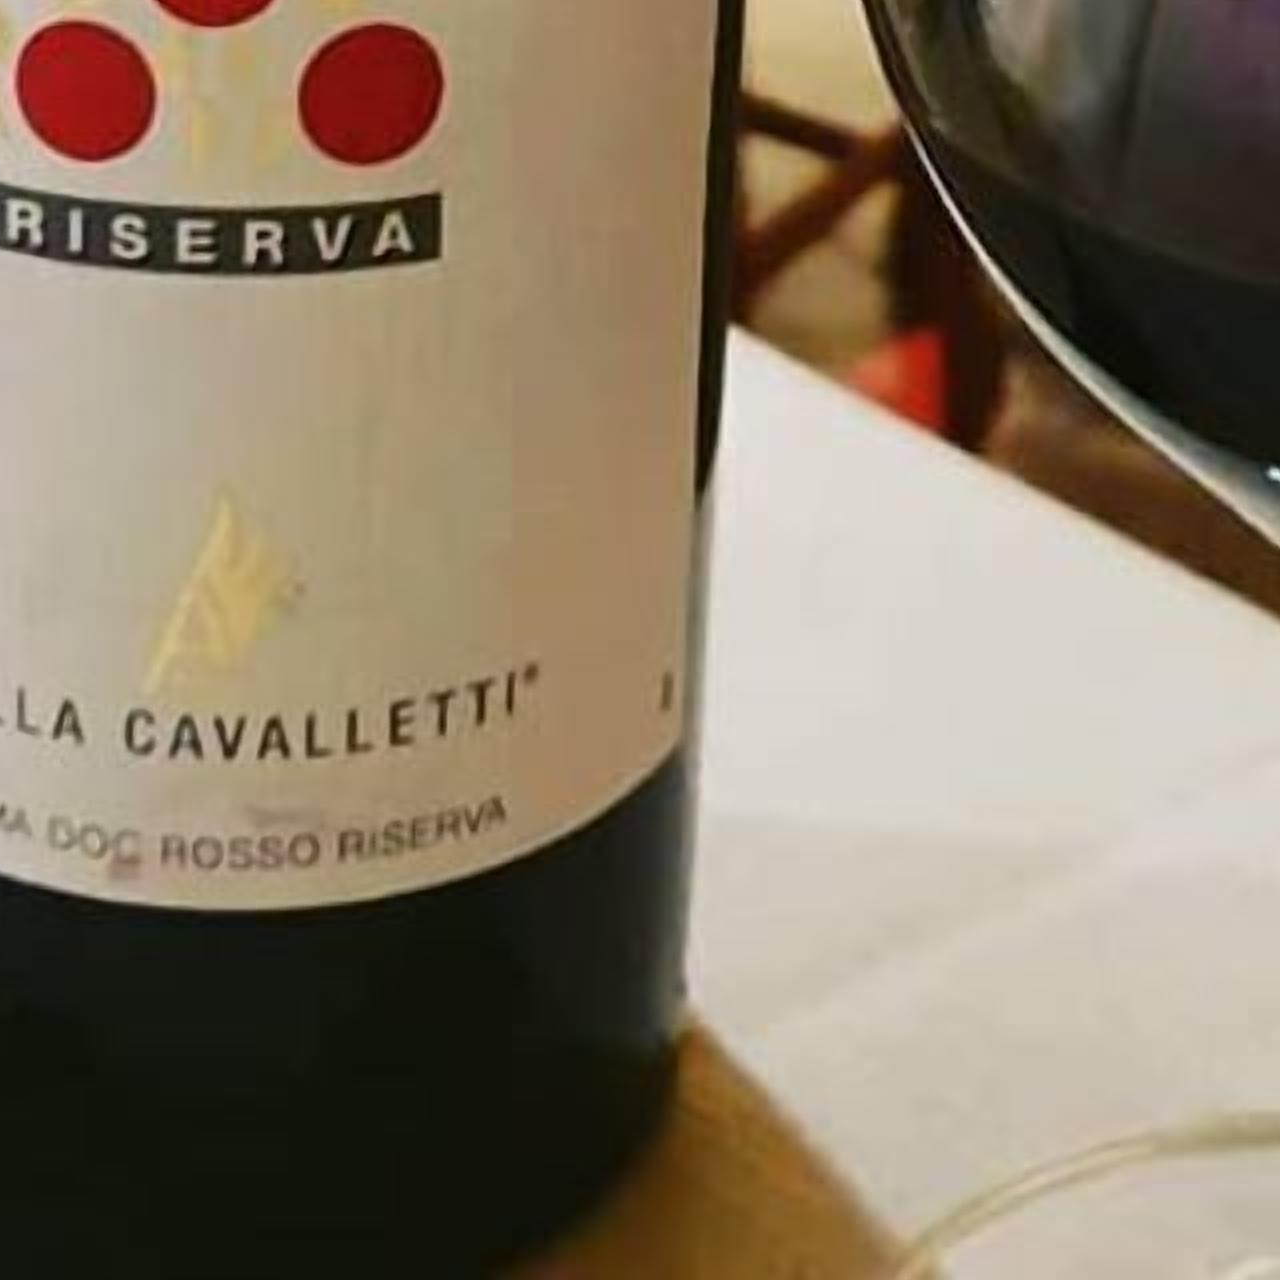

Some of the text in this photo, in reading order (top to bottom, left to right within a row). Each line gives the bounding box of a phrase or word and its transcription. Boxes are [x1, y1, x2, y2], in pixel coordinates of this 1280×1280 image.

[2, 196, 416, 268] RISERVA
[123, 670, 517, 762] CAVALLETTI
[48, 814, 142, 866] DOC
[160, 834, 322, 872] ROSSO
[335, 794, 510, 866] RISERVA
